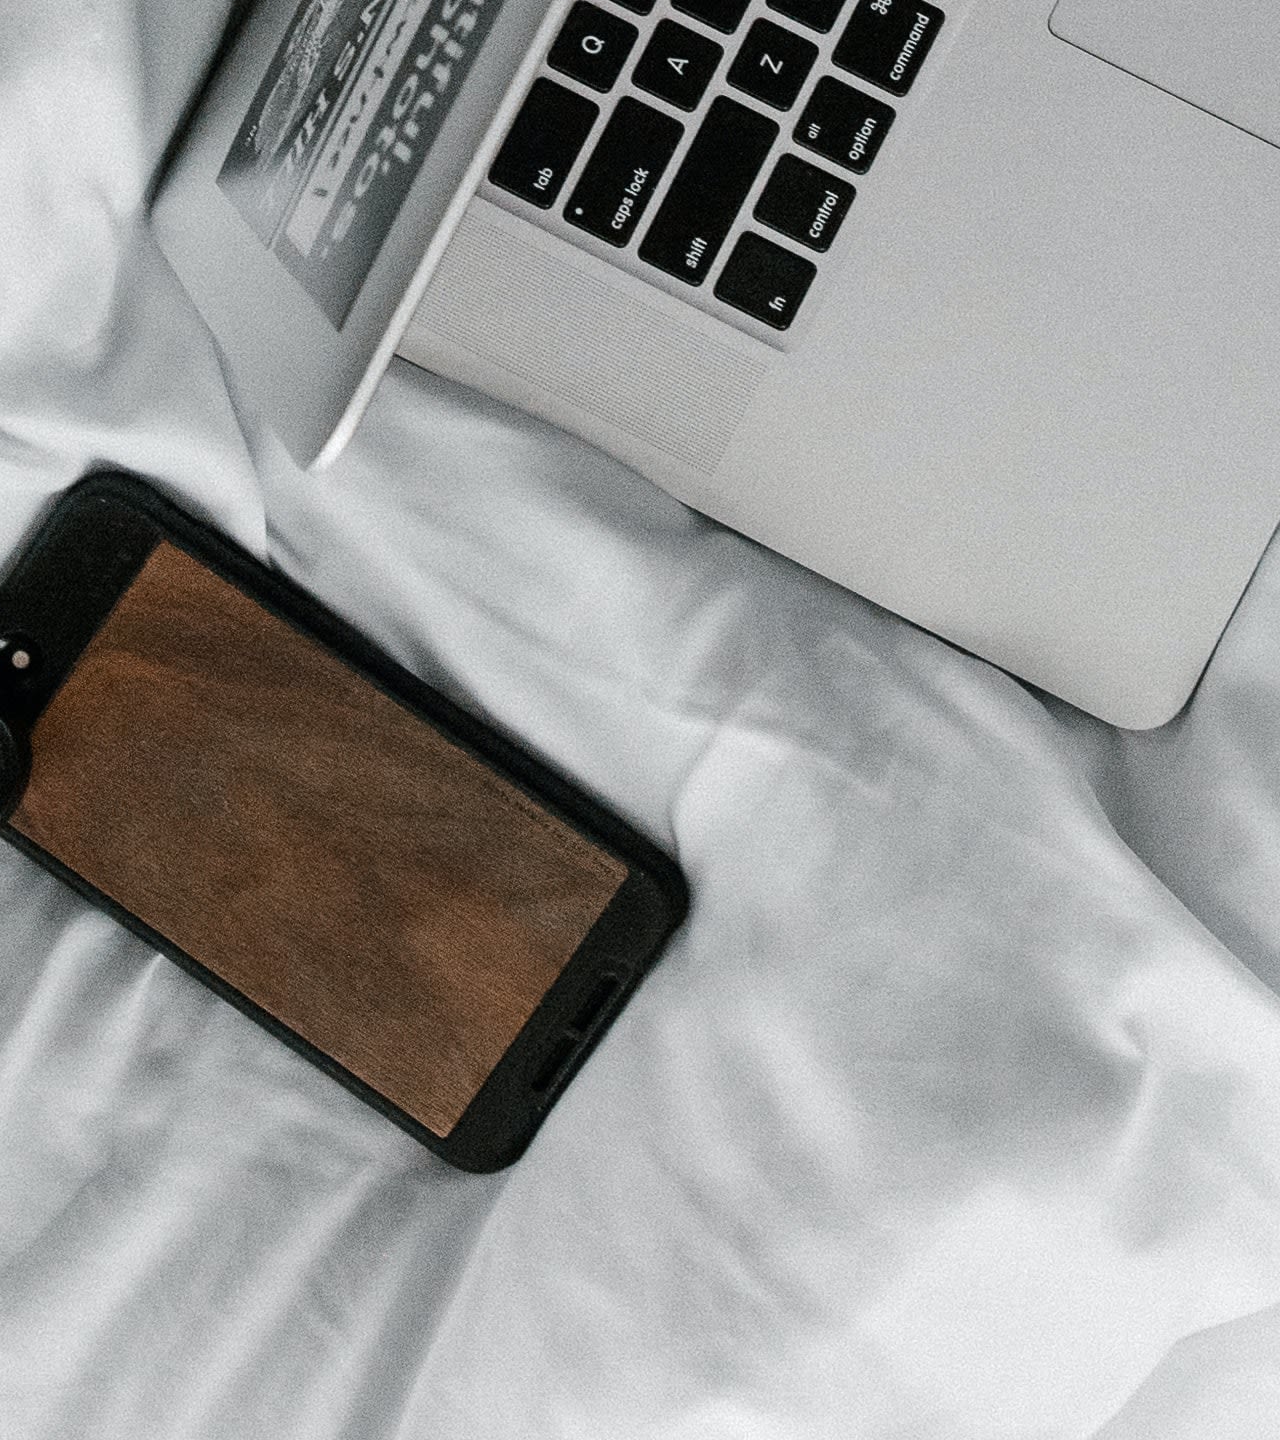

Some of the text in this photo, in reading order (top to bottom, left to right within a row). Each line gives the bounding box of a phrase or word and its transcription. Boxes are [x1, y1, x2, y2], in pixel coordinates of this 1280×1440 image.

[581, 35, 605, 55] Q
[889, 12, 930, 81] command
[667, 57, 689, 75] A
[759, 53, 784, 74] Z
[808, 123, 821, 139] alt
[848, 117, 877, 161] option
[533, 167, 553, 191] tab
[611, 167, 649, 230] caps lock
[809, 190, 839, 239] control
[685, 237, 708, 269] shift
[768, 296, 786, 312] fn
